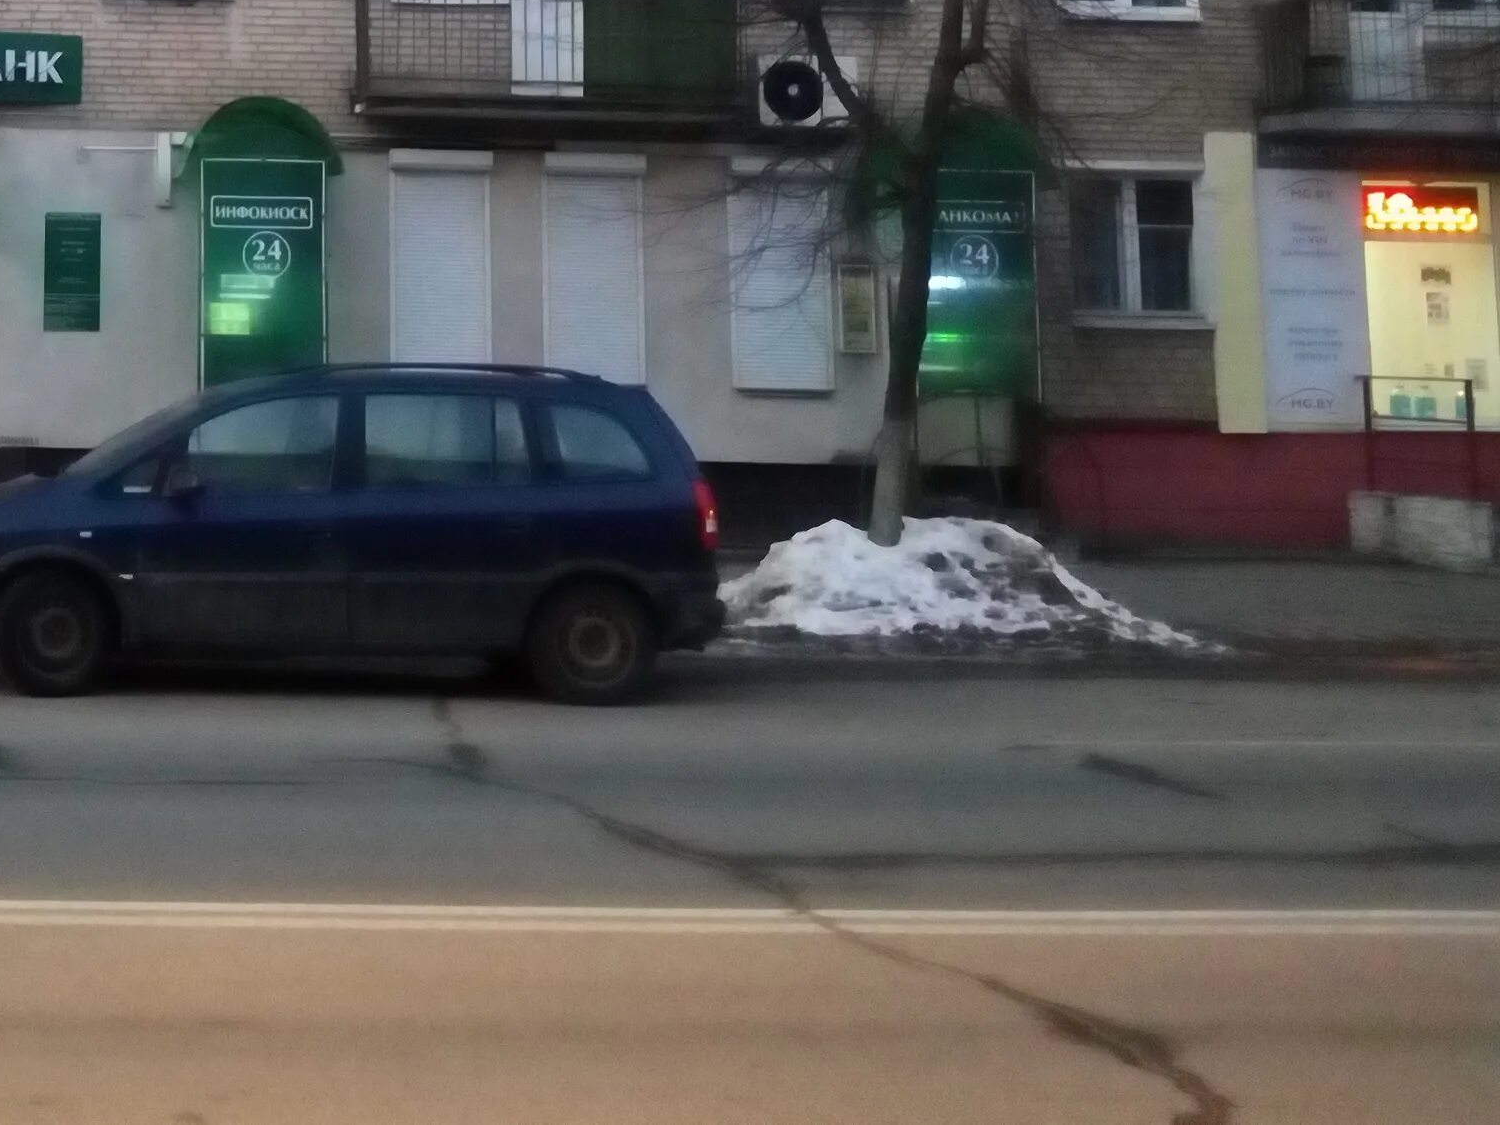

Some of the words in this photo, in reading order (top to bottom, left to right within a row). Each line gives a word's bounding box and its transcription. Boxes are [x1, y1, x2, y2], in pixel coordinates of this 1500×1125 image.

[215, 205, 309, 220] ИНФОКИОСК
[251, 239, 282, 261] 24
[959, 243, 990, 265] 24
[1290, 398, 1336, 410] MG.BY
